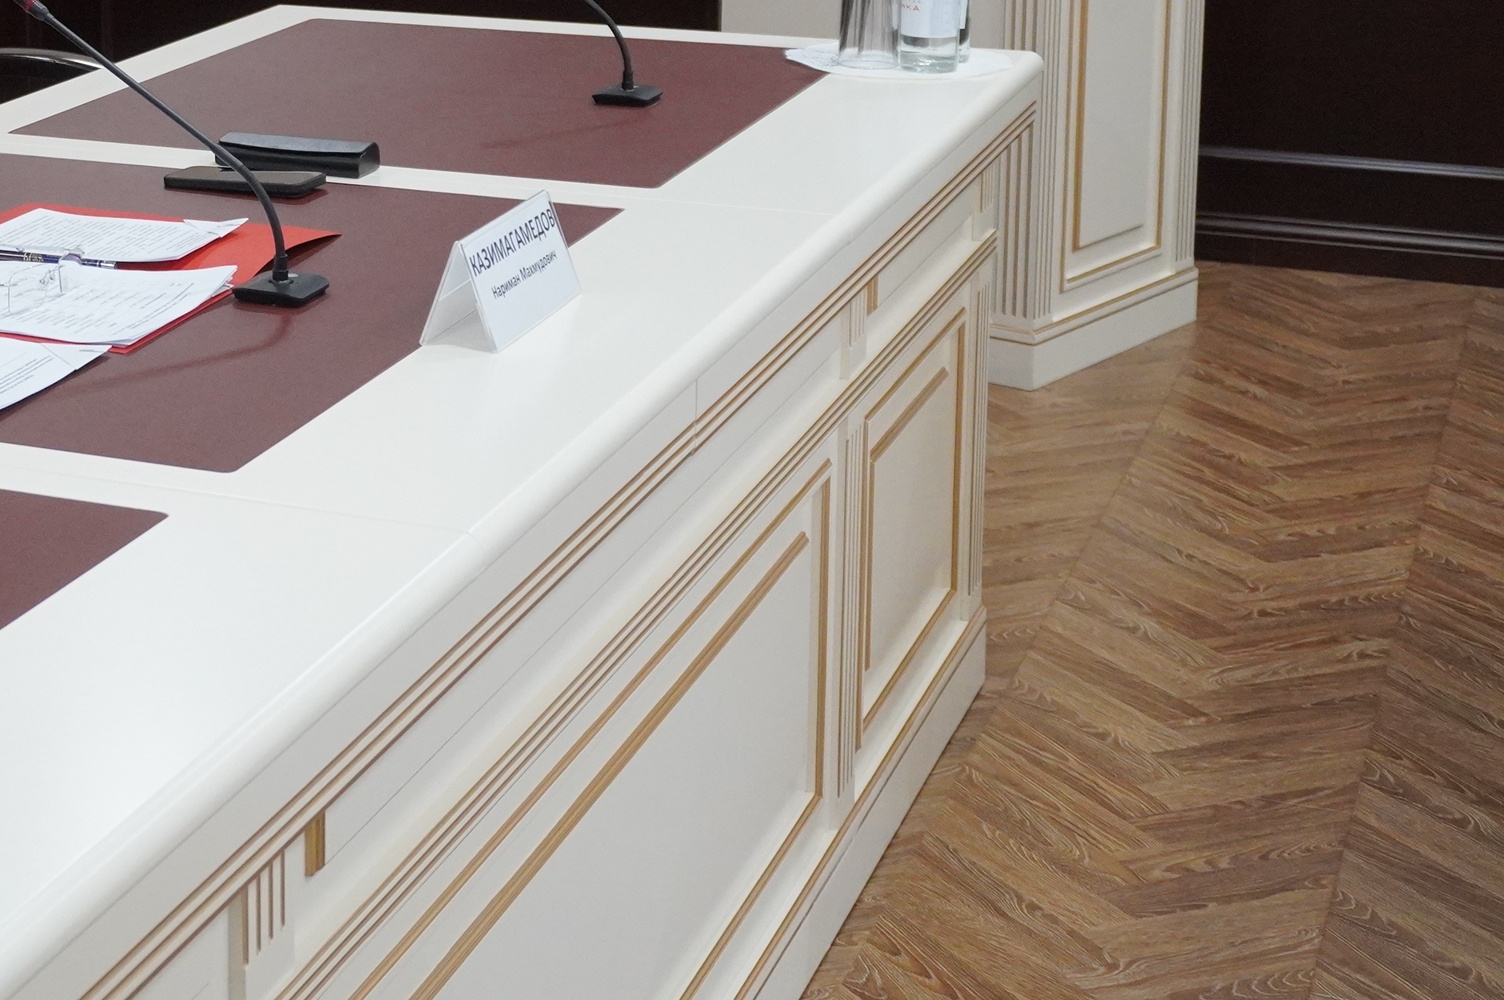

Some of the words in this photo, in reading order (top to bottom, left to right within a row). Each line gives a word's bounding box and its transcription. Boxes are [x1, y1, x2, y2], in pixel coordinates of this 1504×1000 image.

[469, 208, 556, 277] КАЗИМАГАМЕДОВ
[491, 275, 522, 299] Нариман
[519, 250, 558, 282] Махмудович
